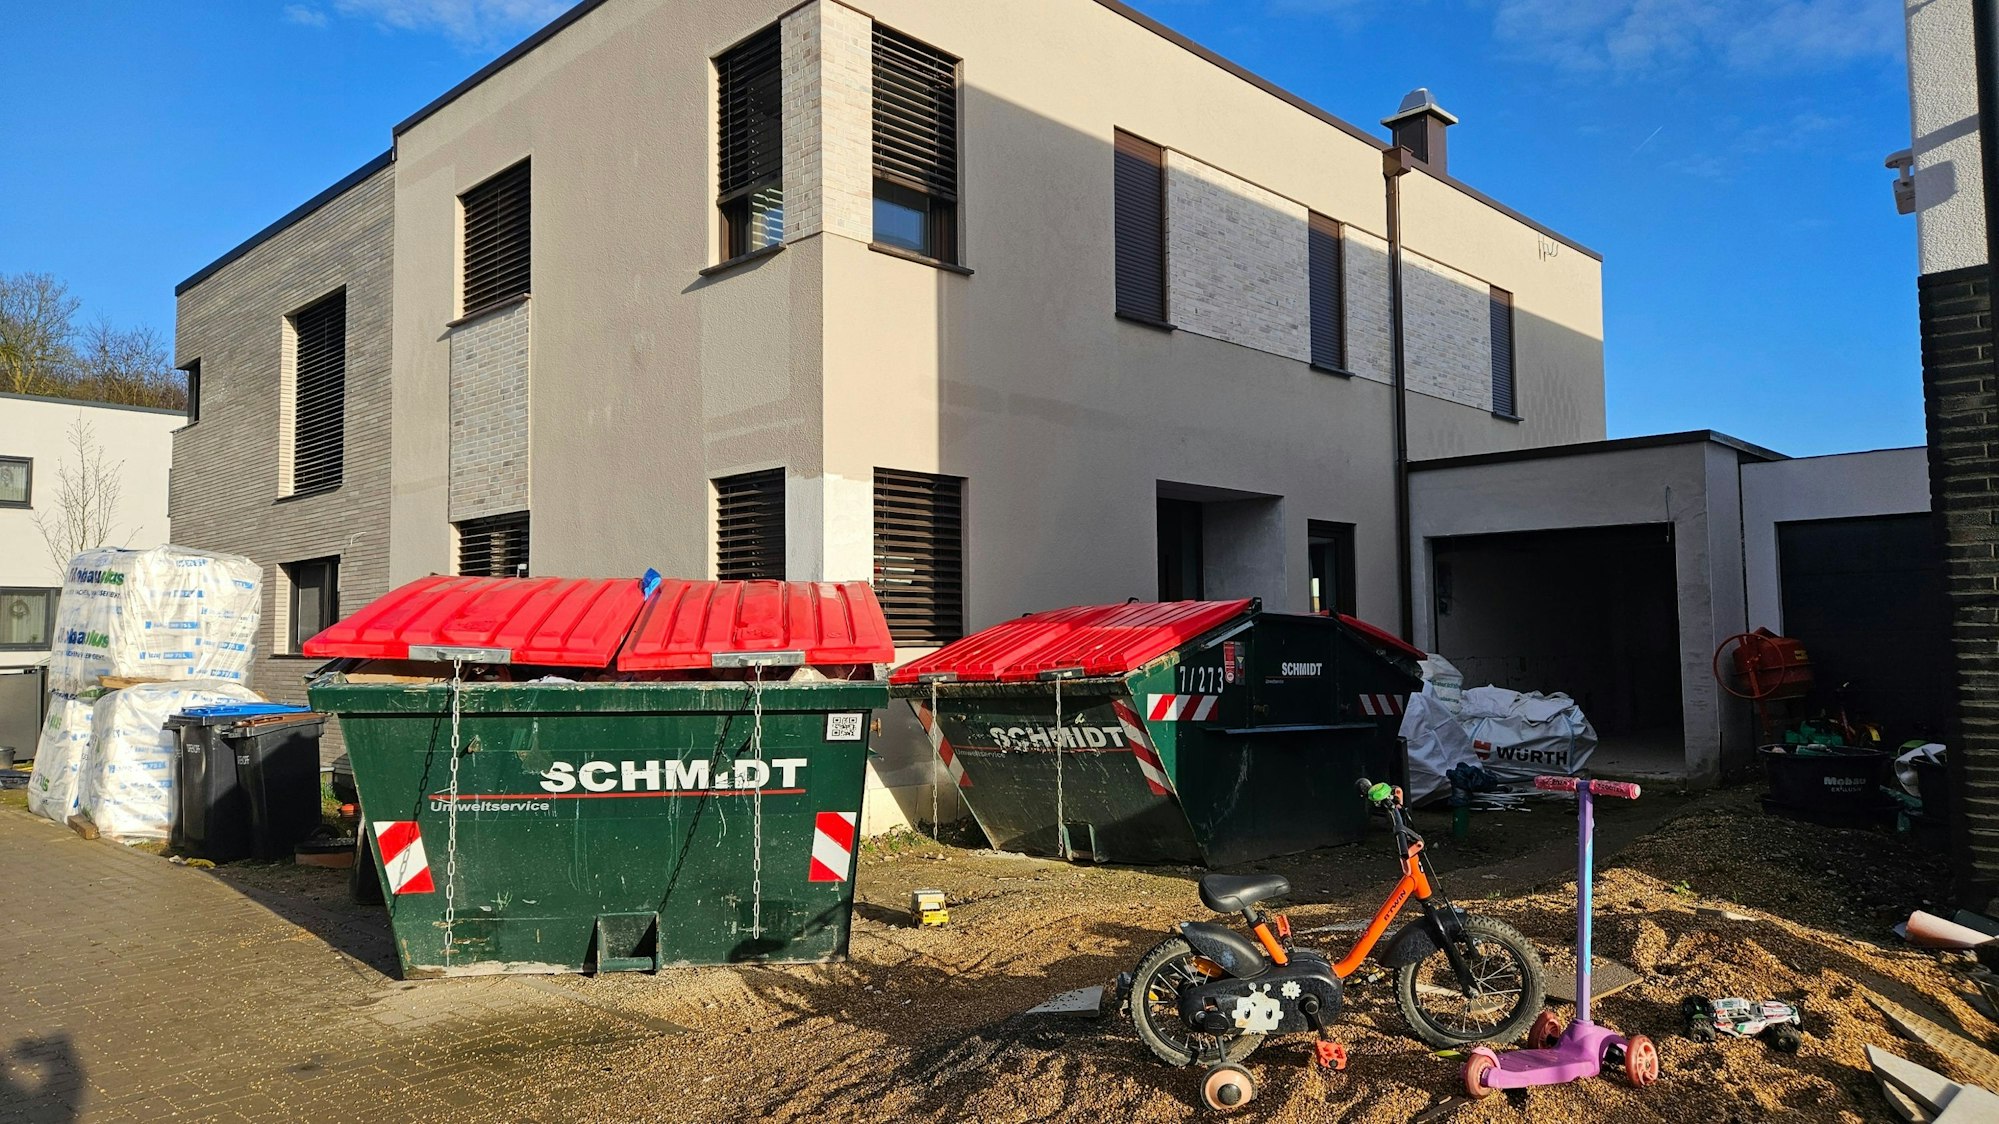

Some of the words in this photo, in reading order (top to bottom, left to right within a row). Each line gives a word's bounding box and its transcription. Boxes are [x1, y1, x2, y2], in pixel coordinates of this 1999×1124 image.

[1282, 662, 1322, 676] SCHMIDT
[1180, 666, 1224, 693] 7/273
[1496, 746, 1567, 765] WÜRTH
